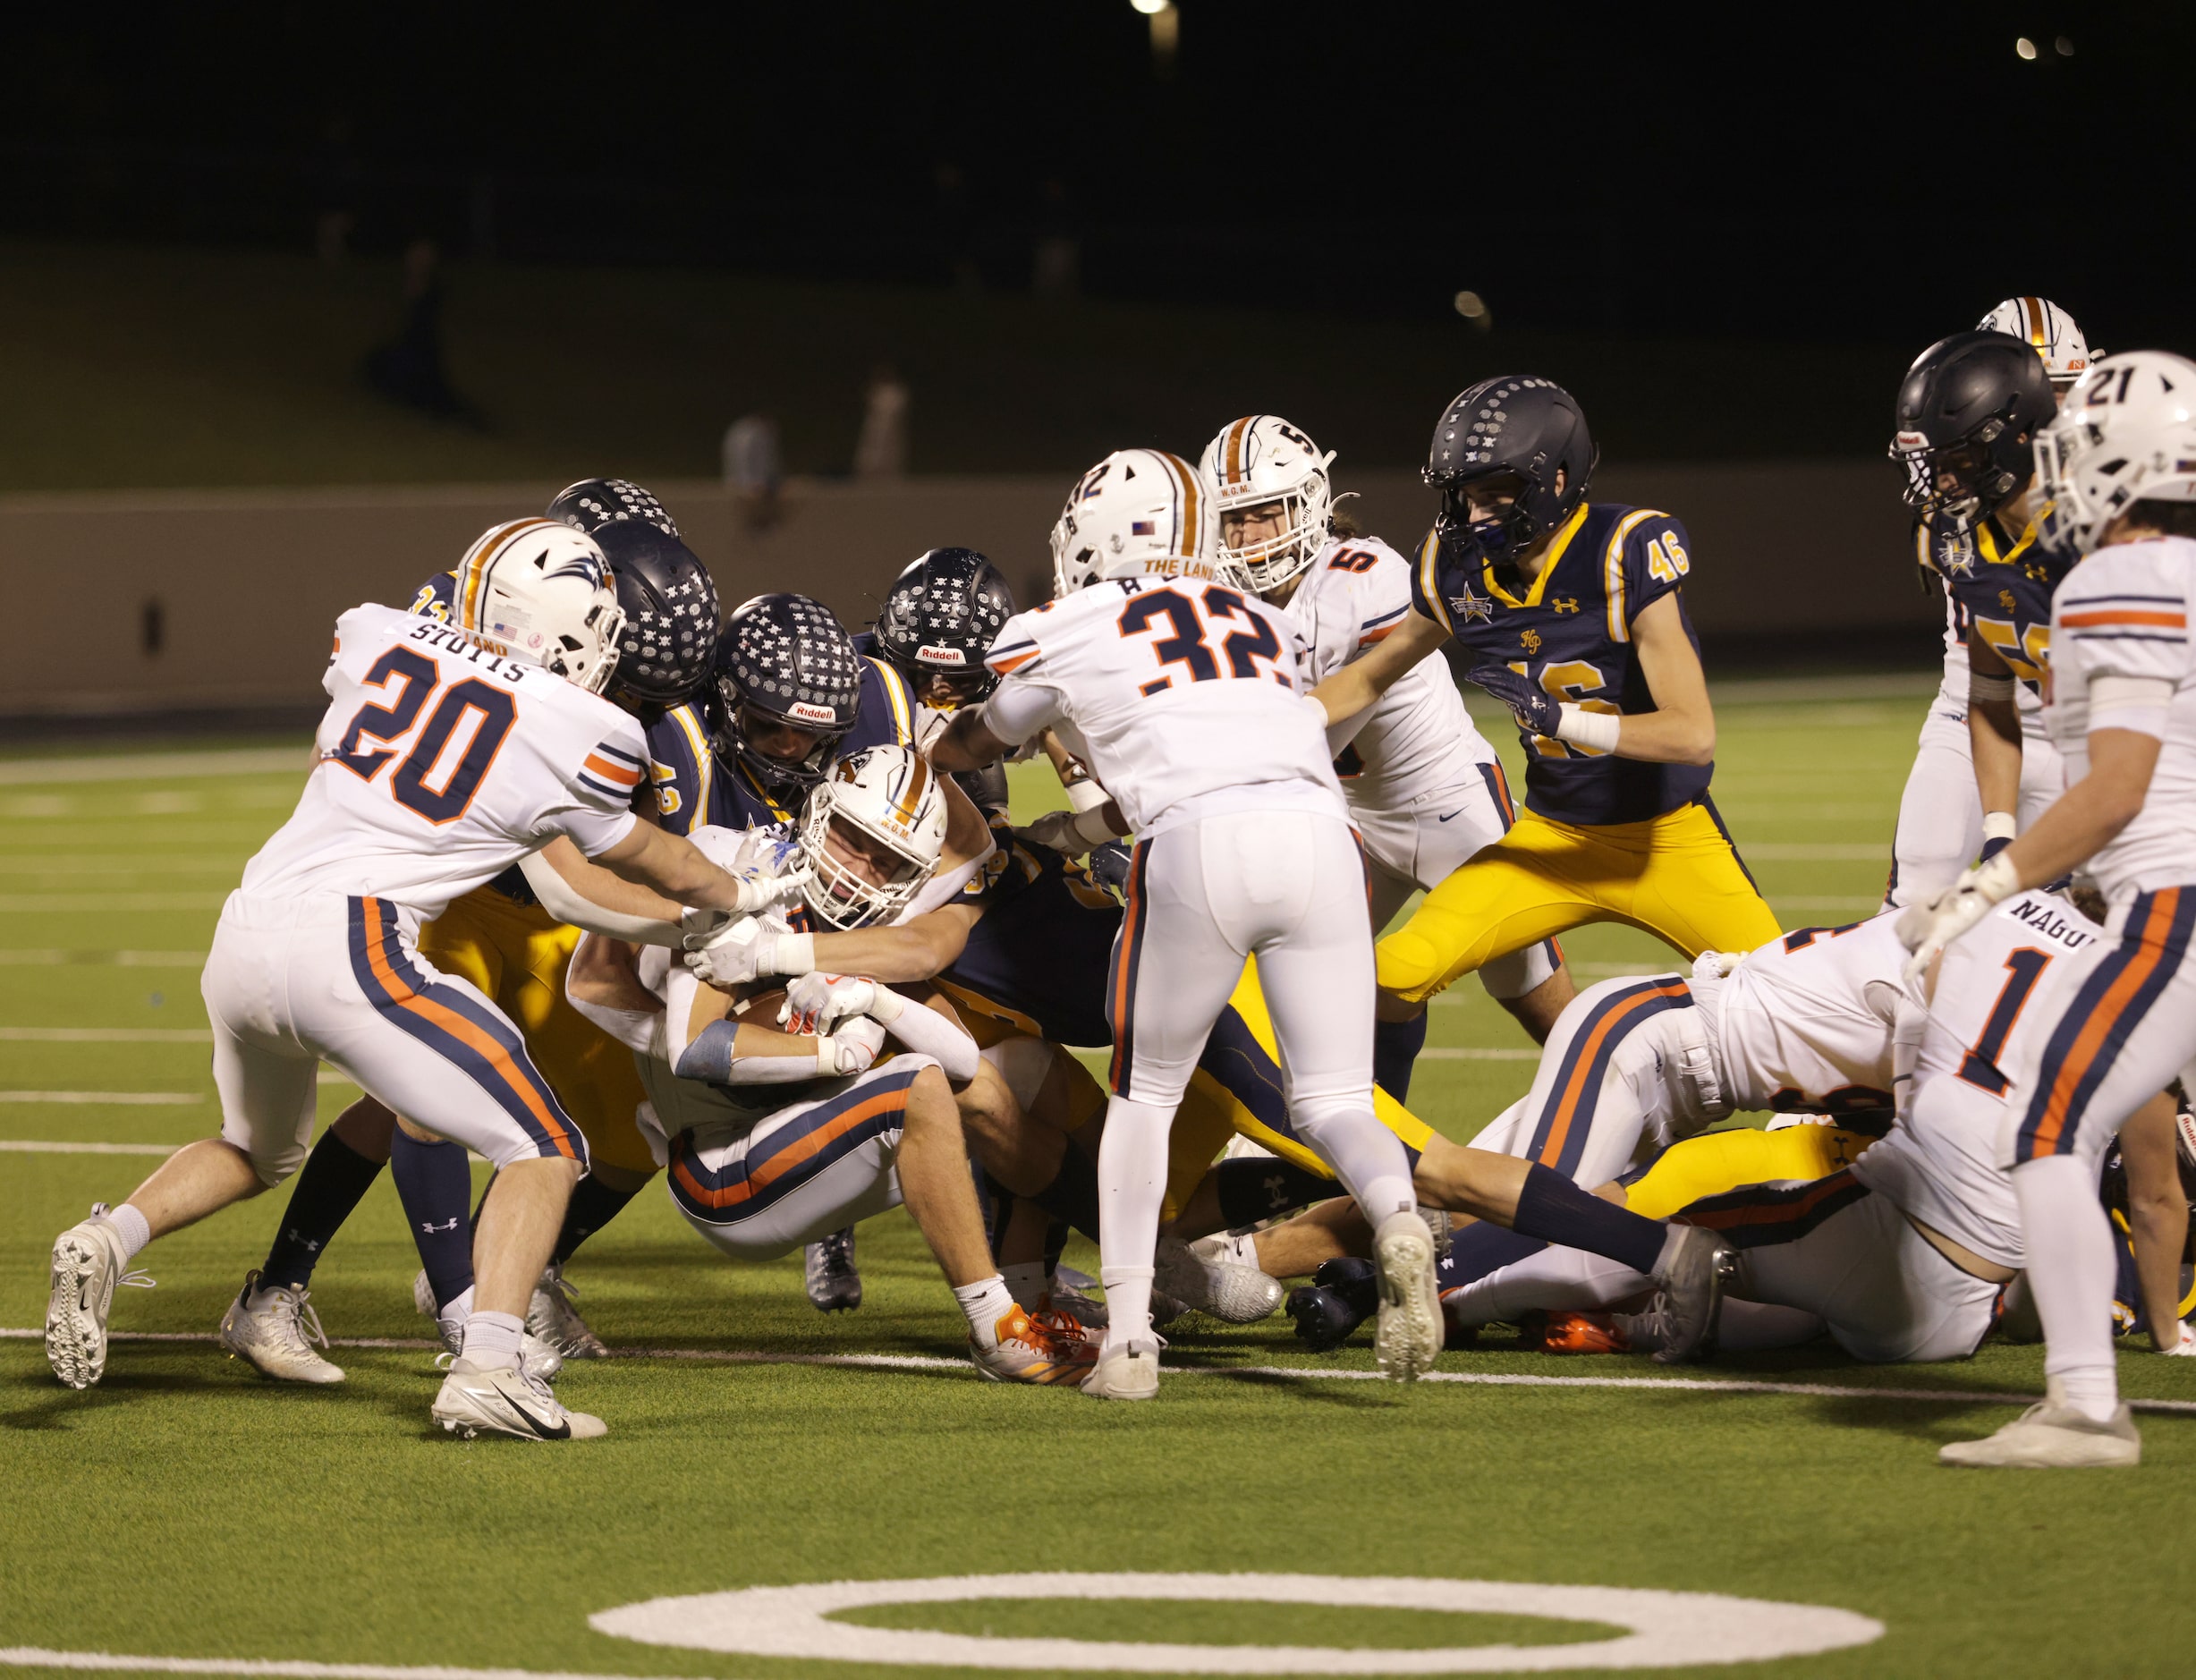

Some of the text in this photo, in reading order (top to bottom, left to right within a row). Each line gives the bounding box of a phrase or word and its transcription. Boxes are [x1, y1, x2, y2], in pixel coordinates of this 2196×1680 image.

[2087, 366, 2135, 407] 21
[1279, 424, 1314, 455] 5
[1144, 559, 1214, 581] THE LAND
[1327, 547, 1378, 573] 5
[1647, 530, 1690, 583] 46
[922, 649, 959, 660] Riddell
[1116, 586, 1293, 697] 32
[796, 706, 833, 719] Riddell
[322, 643, 519, 827] 20
[2010, 899, 2097, 948] NAGU
[1954, 946, 2055, 1099] 1
